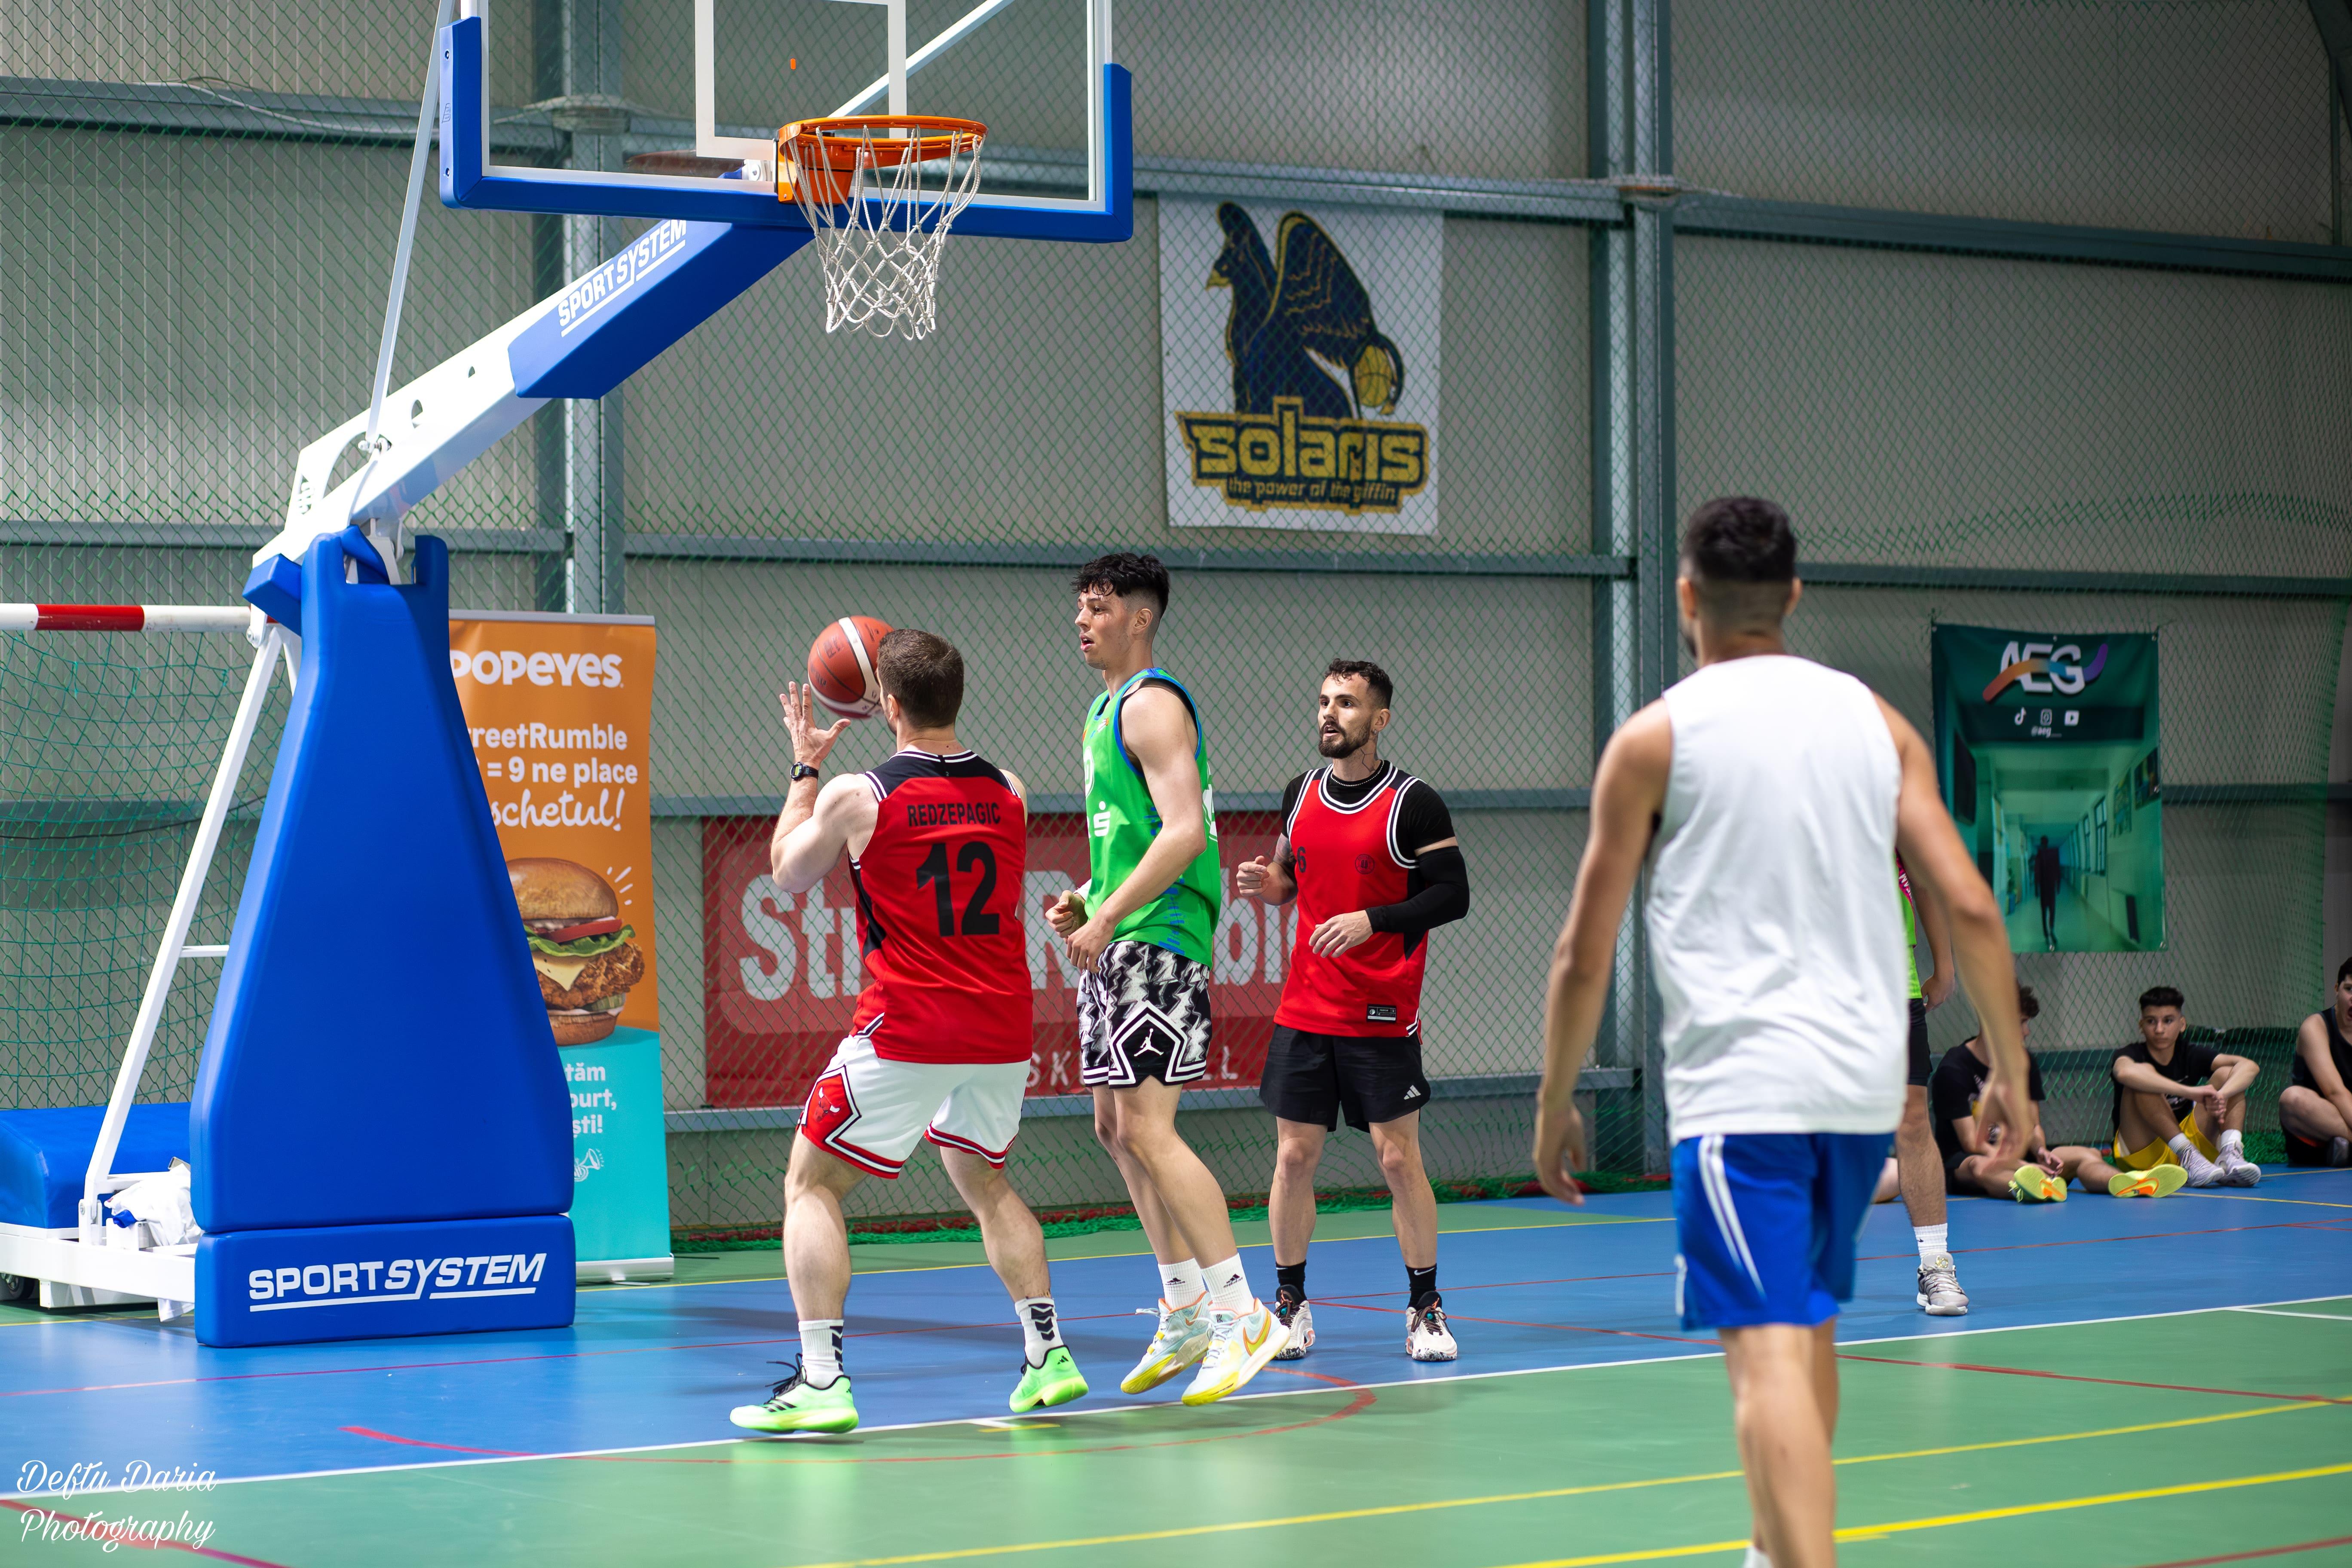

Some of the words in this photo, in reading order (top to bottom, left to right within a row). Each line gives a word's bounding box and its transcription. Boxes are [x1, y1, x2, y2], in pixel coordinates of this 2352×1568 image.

[1191, 410, 1420, 483] solaris
[1255, 481, 1305, 498] power
[2000, 641, 2086, 695] AEG
[508, 756, 525, 783] 9
[532, 761, 567, 783] ne
[573, 757, 638, 789] place
[907, 802, 1001, 827] REDZEPAGIC
[916, 841, 1000, 937] 12
